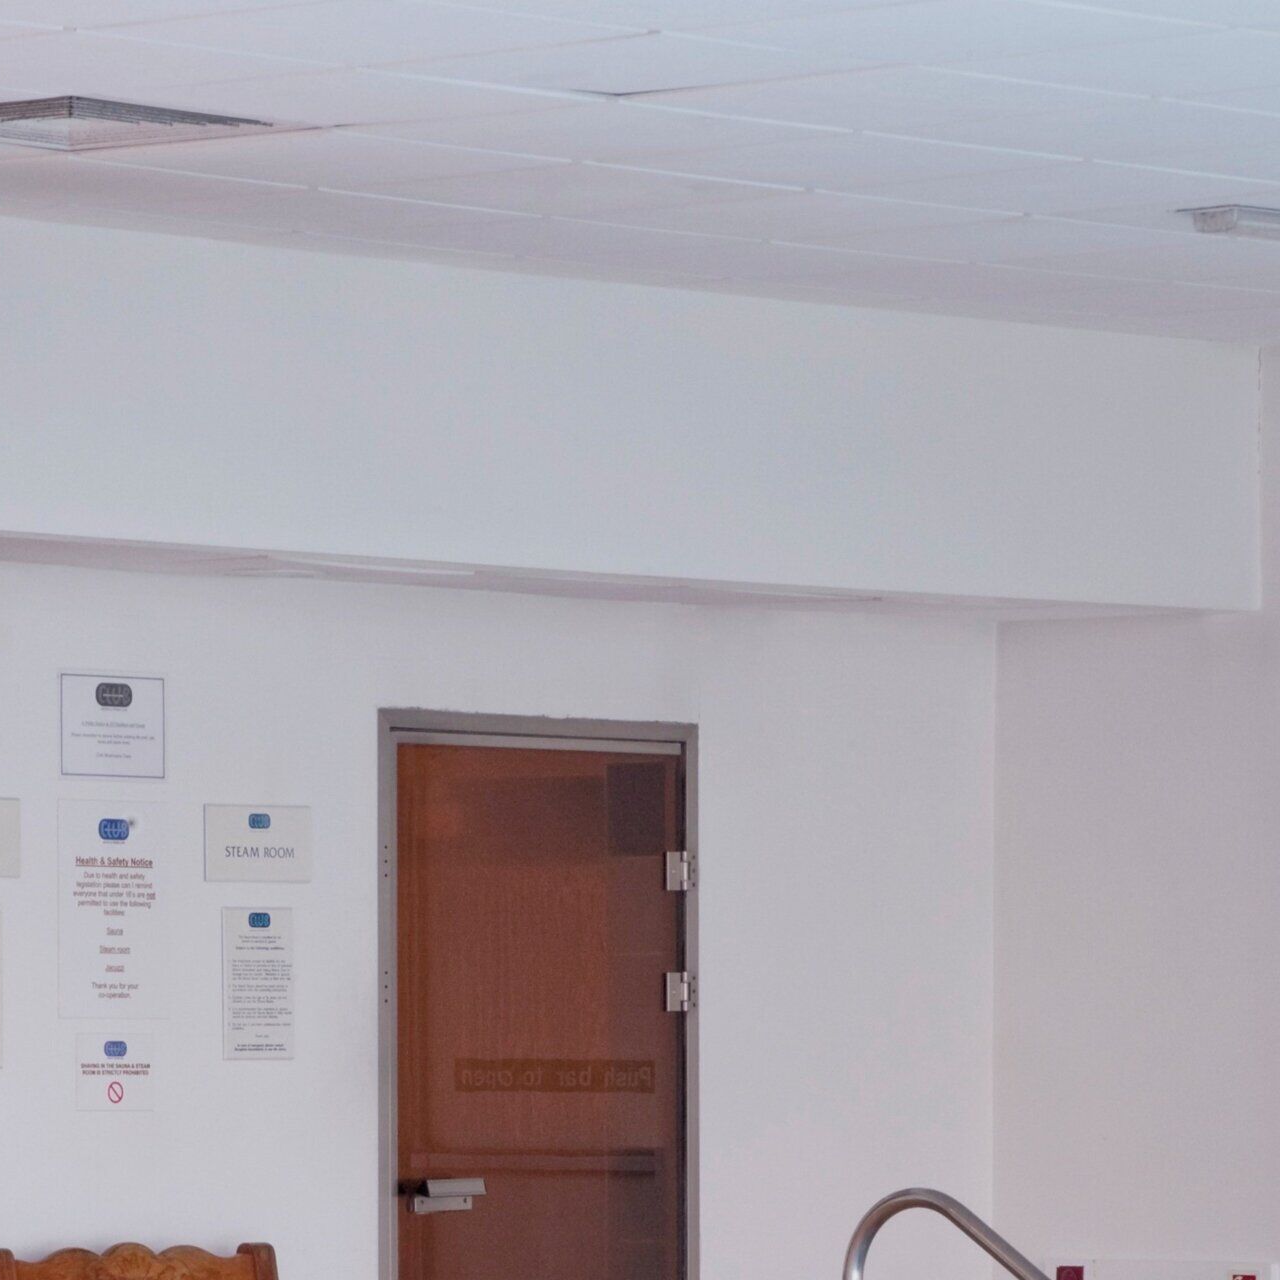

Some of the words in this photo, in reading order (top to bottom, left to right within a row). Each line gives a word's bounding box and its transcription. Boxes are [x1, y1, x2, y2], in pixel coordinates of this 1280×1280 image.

[225, 846, 260, 858] STEAM
[263, 847, 295, 858] ROOM
[75, 856, 98, 865] Health
[100, 857, 105, 865] &
[107, 857, 129, 867] Safety
[130, 858, 153, 867] Notice
